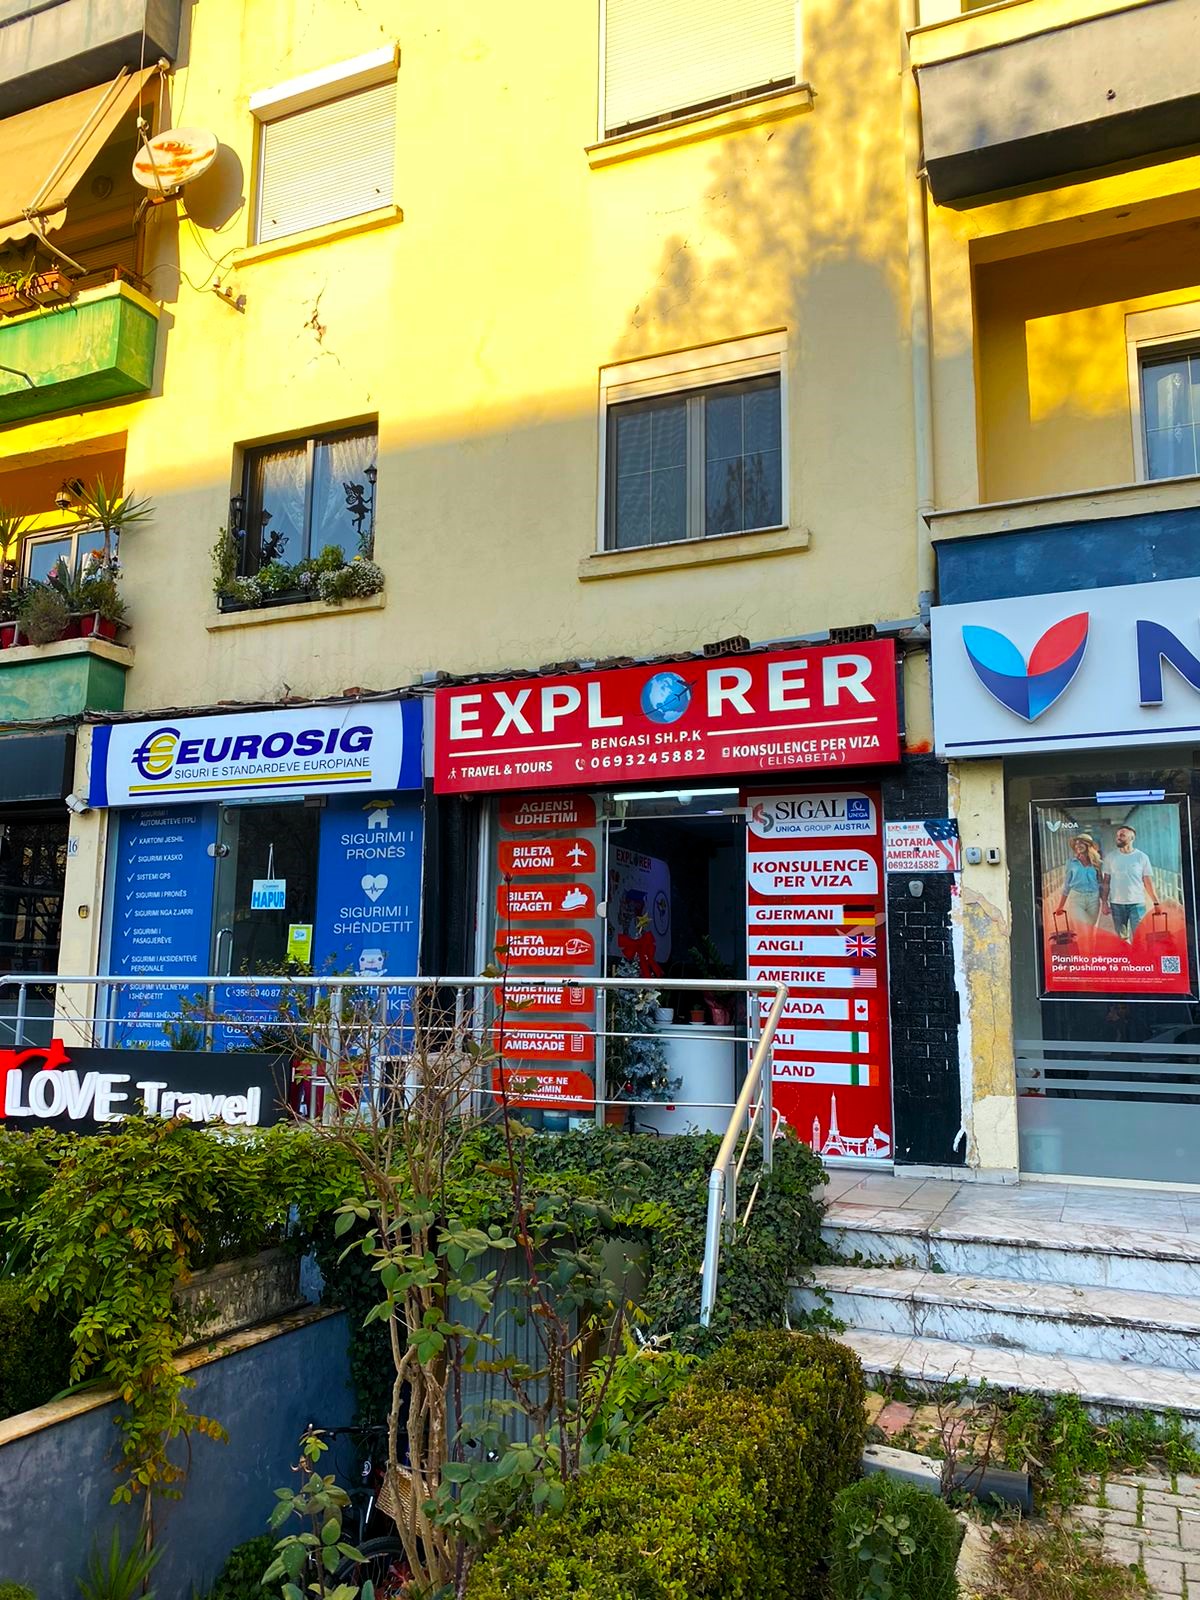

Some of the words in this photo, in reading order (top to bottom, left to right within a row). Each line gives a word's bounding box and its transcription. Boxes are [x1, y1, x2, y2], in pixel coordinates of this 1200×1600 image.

[176, 725, 374, 765] EUROSIG
[591, 734, 650, 750] BENGASI
[655, 730, 701, 745] SH.P.K
[732, 741, 817, 758] KONSULENCE
[820, 737, 847, 751] PER
[850, 734, 880, 749] VIZA
[590, 748, 706, 768] 0693245882
[174, 767, 210, 780] SIGURI
[212, 766, 218, 777] E
[221, 760, 301, 776] STANDARDEVE
[303, 756, 370, 771] EUROPIANE
[461, 764, 501, 778] TRAVEL
[503, 763, 513, 775] &
[515, 760, 553, 774] TOURS
[519, 800, 574, 813] AGJENSI
[775, 799, 846, 820] SIGAL
[514, 812, 578, 825] UDHETIMI
[775, 825, 801, 833] UNIQA
[804, 824, 832, 832] GROUP
[833, 823, 871, 832] AUSTRIA
[1061, 821, 1080, 830] NOA
[340, 831, 406, 845] SIGURIMI
[410, 830, 414, 842] I
[68, 840, 78, 853] 16
[512, 846, 552, 857] BILETA
[138, 855, 162, 863] SIGURIMI
[887, 850, 940, 859] AMERIKANE
[512, 857, 554, 868] AVIONI
[752, 859, 869, 874] KONSULENCE
[136, 873, 158, 881] SISTEMI
[773, 875, 806, 888] PER
[810, 874, 853, 887] VIZA
[252, 891, 285, 908] HAPUR
[340, 906, 402, 919] SIGURIMI
[405, 905, 409, 917] I
[507, 902, 552, 912] TRAGETI
[755, 909, 834, 921] GJERMANI
[333, 921, 414, 935] SHËNDETIT
[505, 946, 564, 957] AUTOBUZI
[756, 940, 804, 952] ANGLI
[1051, 954, 1089, 963] Planifiko
[1091, 955, 1131, 965] përpara,
[130, 964, 164, 972] PERSONALE
[1051, 963, 1067, 972] për
[1069, 963, 1107, 973] pushime
[1109, 964, 1119, 972] të
[1121, 963, 1154, 972] mbara!
[757, 970, 826, 983] AMERIKE
[505, 1040, 565, 1051] AMBASADE
[555, 1075, 569, 1086] NE
[5, 1068, 131, 1122] LOVE
[136, 1081, 262, 1127] Travel
